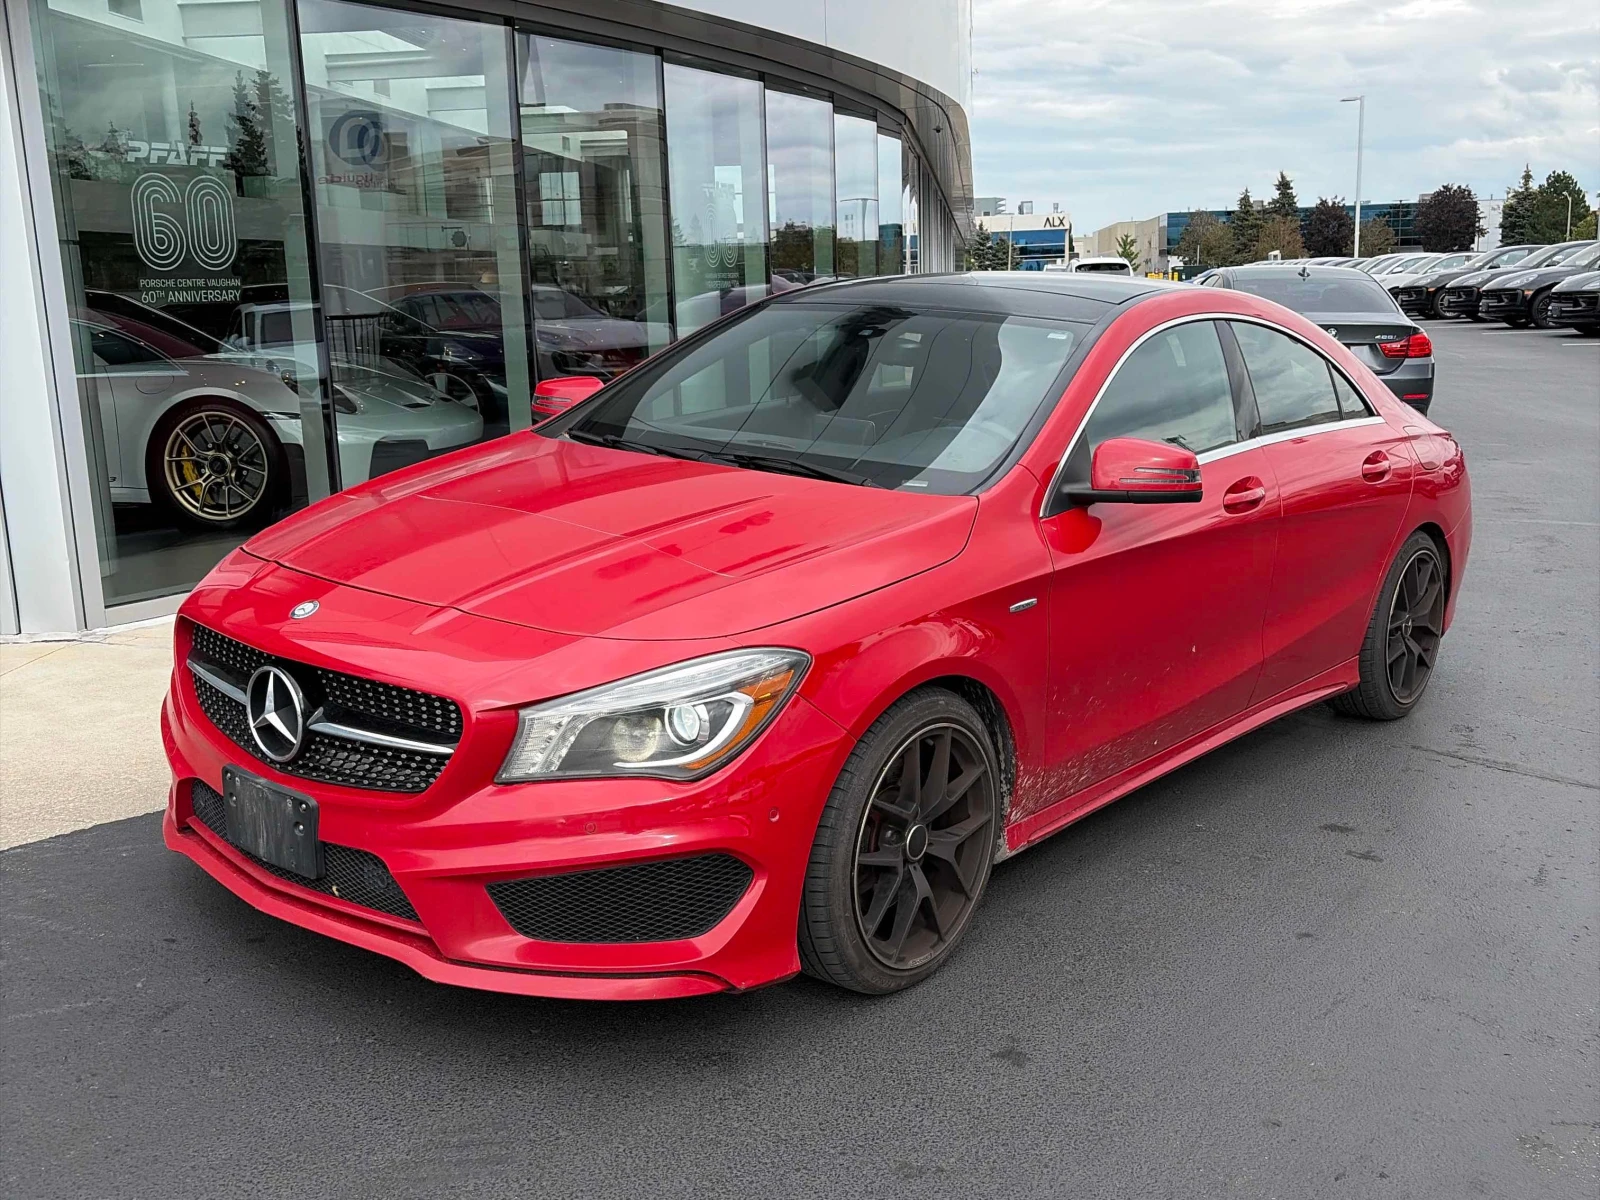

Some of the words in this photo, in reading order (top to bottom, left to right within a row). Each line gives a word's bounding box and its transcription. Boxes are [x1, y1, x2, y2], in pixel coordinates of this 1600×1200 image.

[127, 140, 227, 167] PFAFF
[131, 172, 237, 271] 60
[1044, 216, 1065, 228] ALX
[140, 279, 176, 288] PORSCHE
[177, 278, 206, 287] CENTRE
[207, 278, 241, 287] VAUGHAN
[141, 290, 165, 303] 60TH
[167, 289, 241, 303] ANNIVERSARY
